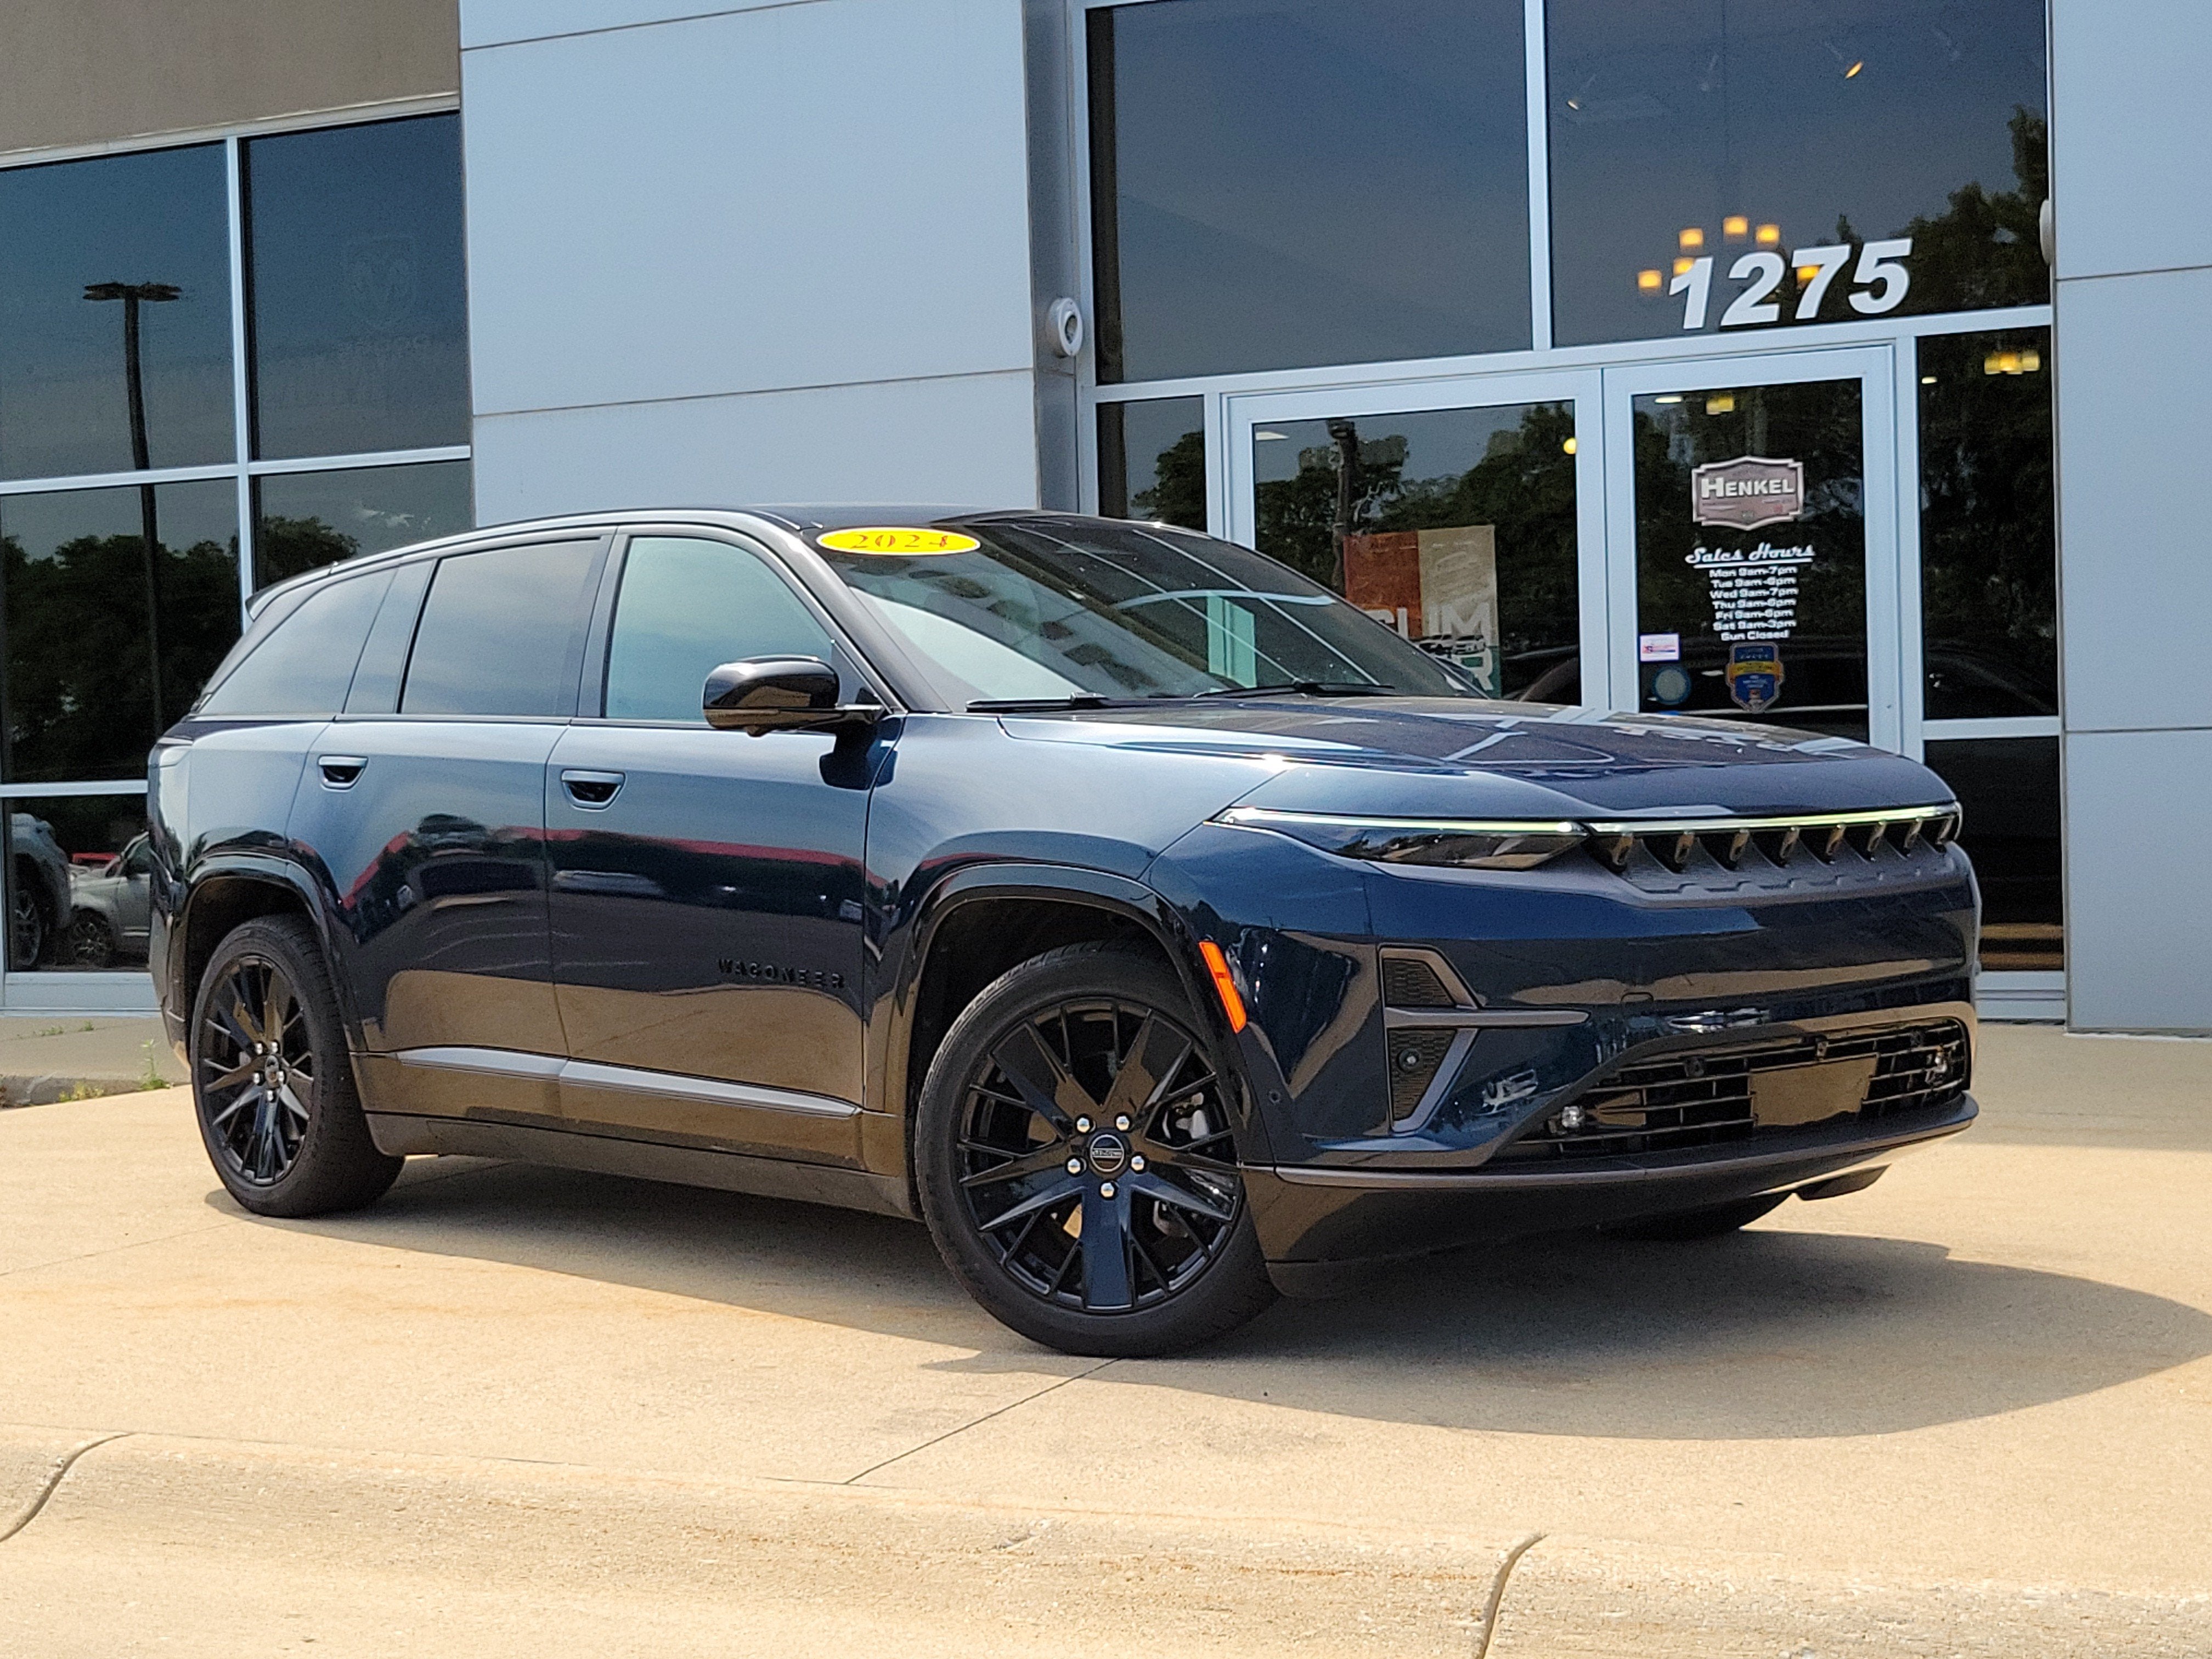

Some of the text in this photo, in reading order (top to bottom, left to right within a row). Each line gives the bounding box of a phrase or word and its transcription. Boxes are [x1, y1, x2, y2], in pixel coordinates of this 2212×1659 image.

[1669, 237, 1912, 330] 1275
[1701, 477, 1795, 499] HENKEL
[850, 534, 949, 549] 2024
[1685, 541, 1816, 563] Sales Hours
[1709, 569, 1737, 578] Mon
[1710, 579, 1733, 589] Tue
[1709, 590, 1737, 599] Wed
[1712, 601, 1736, 609] Thu
[1715, 611, 1734, 620] Fri
[1713, 621, 1736, 631] Sat
[1720, 630, 1790, 641] Sun Closed
[718, 959, 845, 989] WAGONEER
